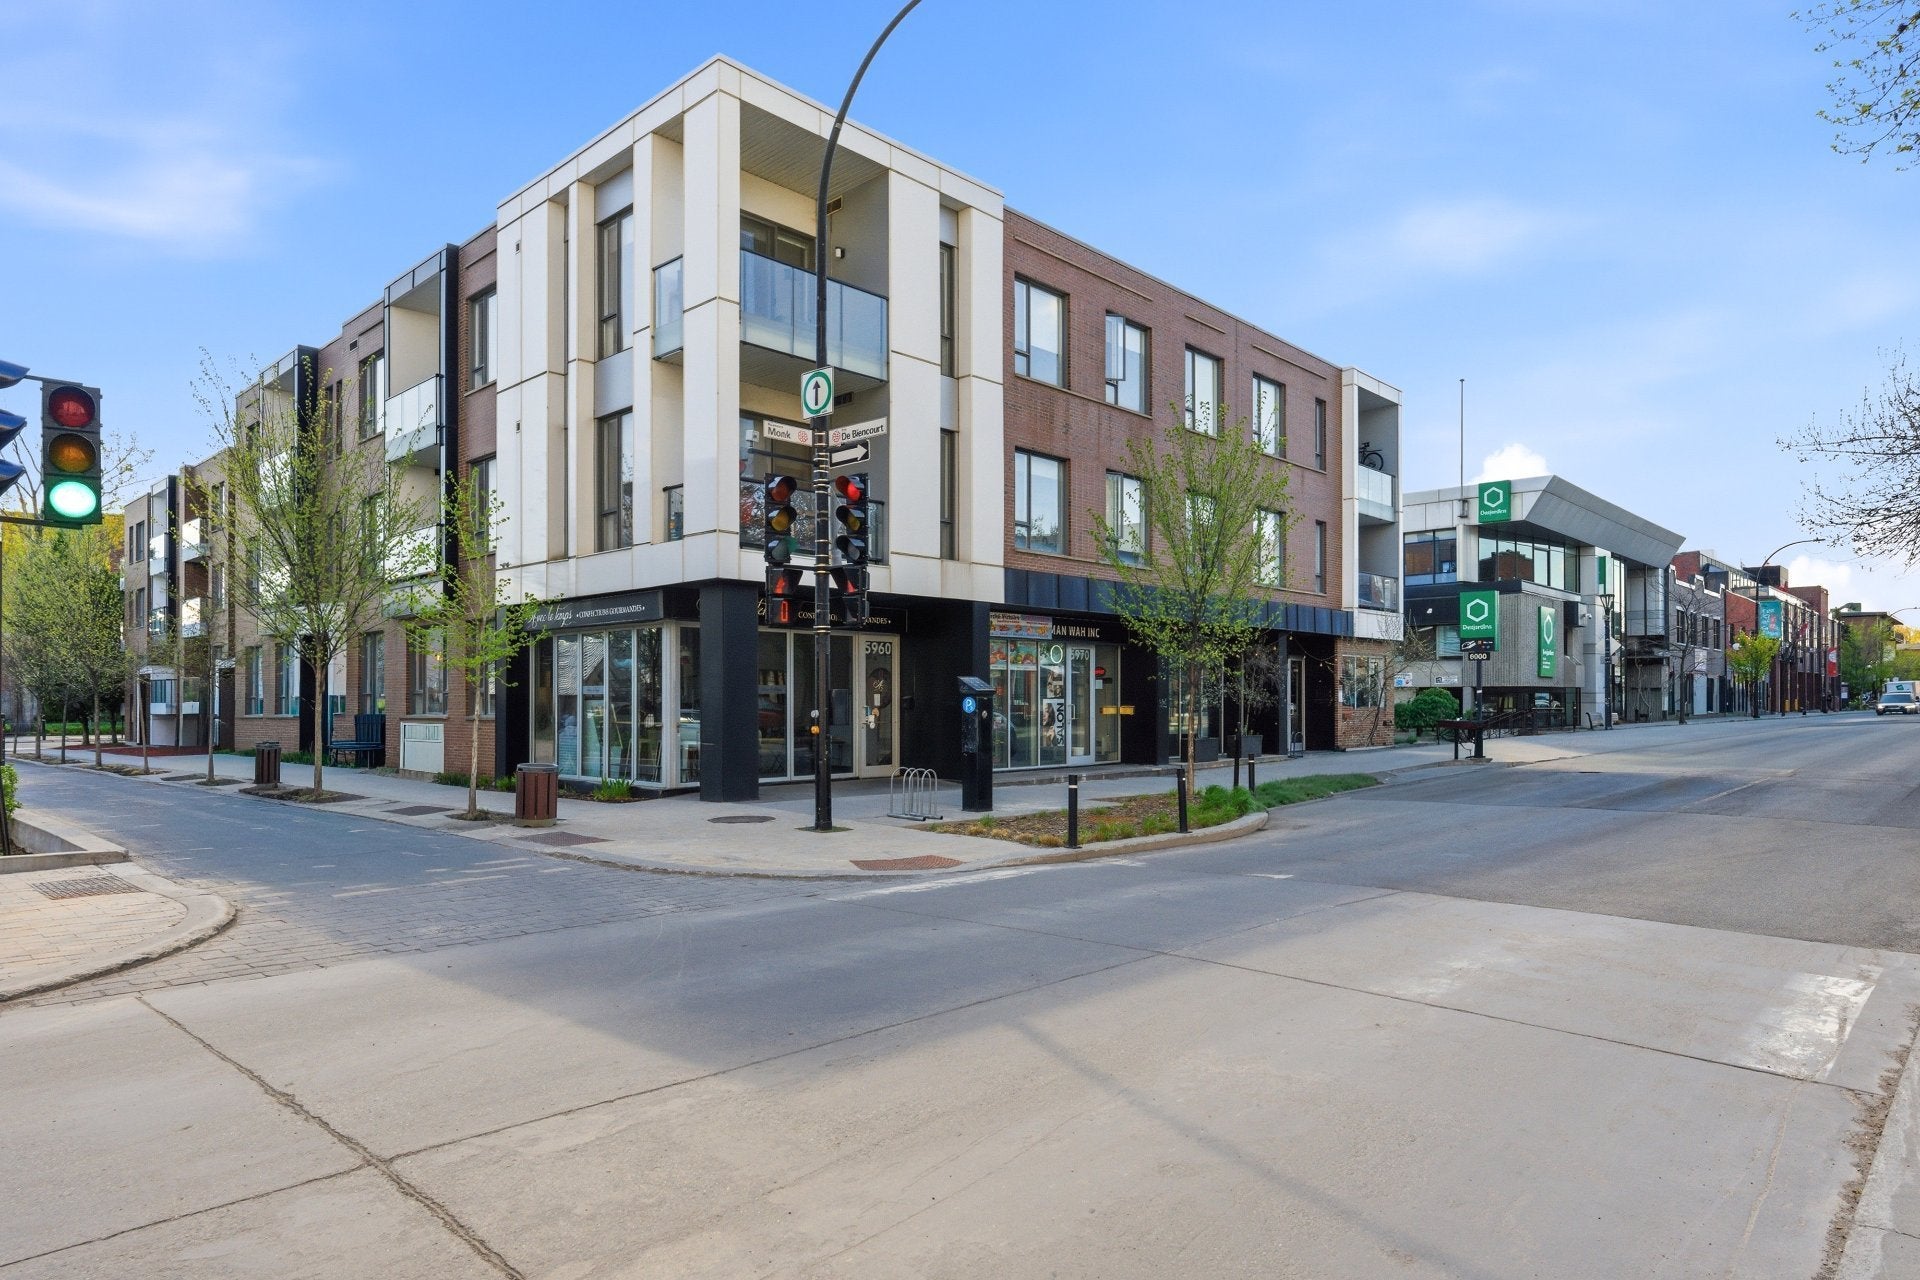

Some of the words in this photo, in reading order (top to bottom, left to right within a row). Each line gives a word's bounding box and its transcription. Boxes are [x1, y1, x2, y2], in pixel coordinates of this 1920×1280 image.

[768, 427, 790, 439] Monk
[841, 432, 850, 441] De
[852, 425, 884, 439] Biencourt
[1480, 508, 1507, 516] Desjardins
[1068, 625, 1086, 637] WAH
[1087, 627, 1100, 638] INC
[866, 641, 891, 655] 5960
[1071, 649, 1089, 661] 5970
